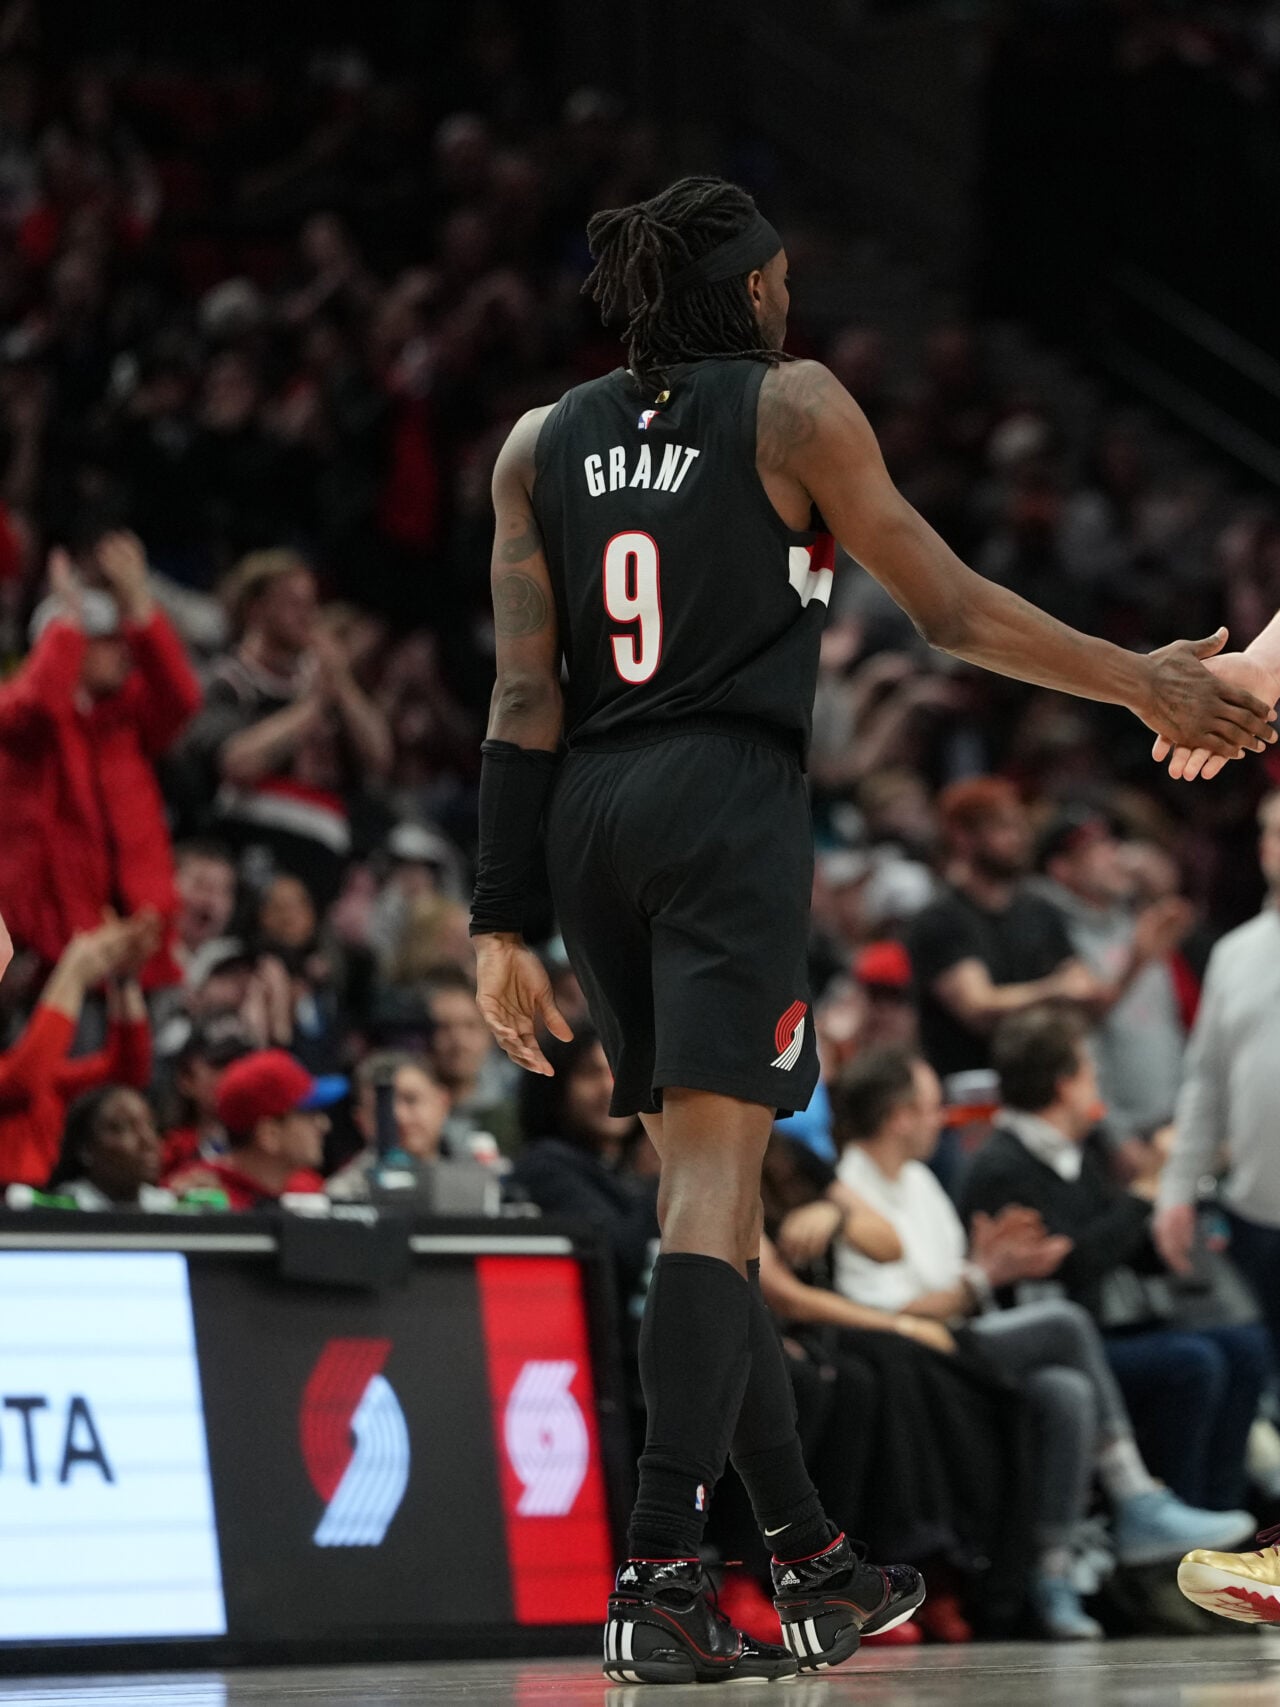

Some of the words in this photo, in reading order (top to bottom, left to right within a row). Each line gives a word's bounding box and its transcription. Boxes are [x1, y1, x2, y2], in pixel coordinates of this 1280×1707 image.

[584, 443, 700, 498] GRANT
[602, 529, 663, 685] 9
[0, 1397, 114, 1483] TA
